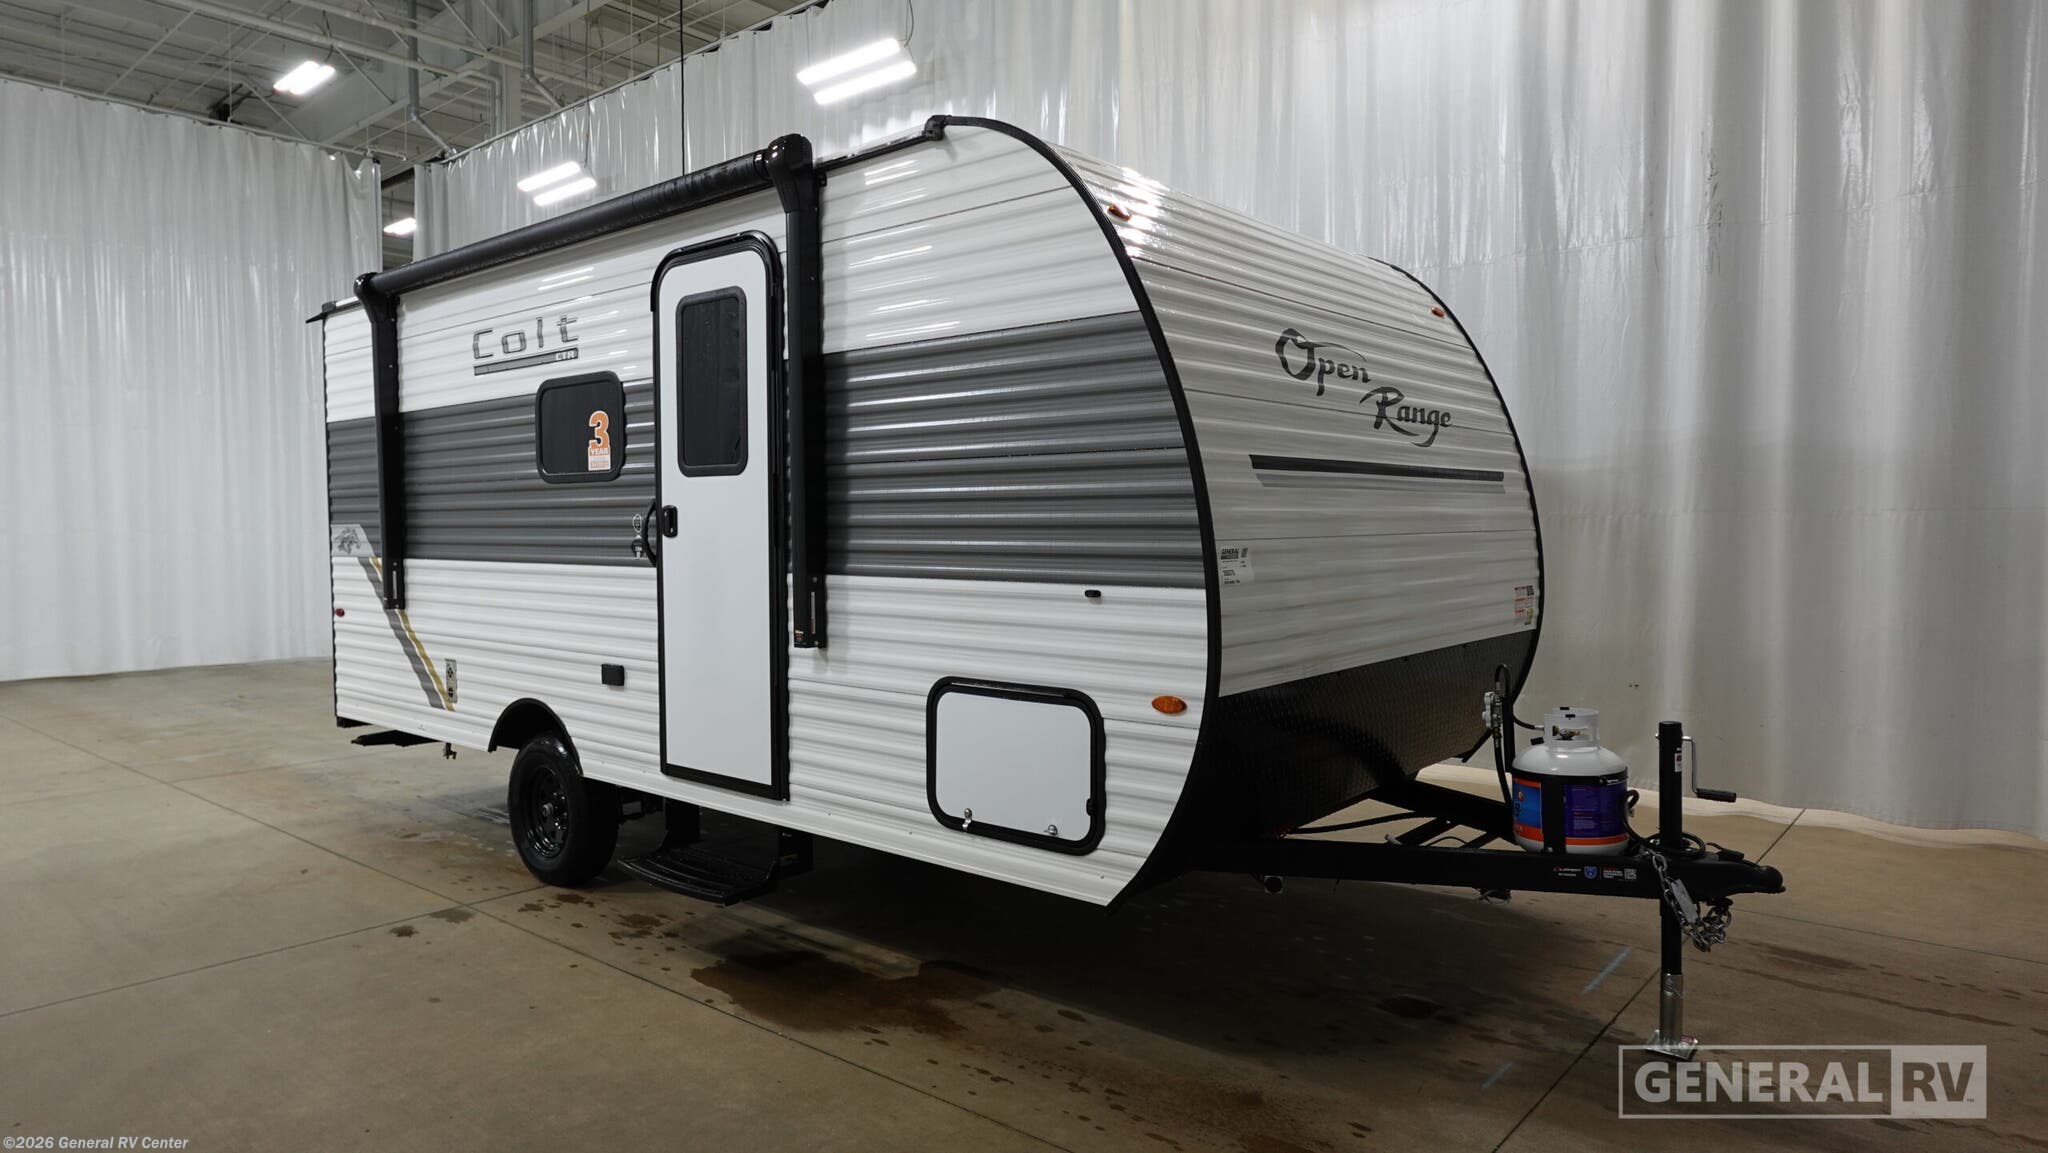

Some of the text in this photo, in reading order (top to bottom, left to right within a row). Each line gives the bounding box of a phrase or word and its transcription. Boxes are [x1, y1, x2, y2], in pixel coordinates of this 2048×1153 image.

[472, 315, 578, 359] Colt
[1275, 328, 1371, 396] Open
[589, 410, 609, 449] 3
[1359, 386, 1452, 447] Range
